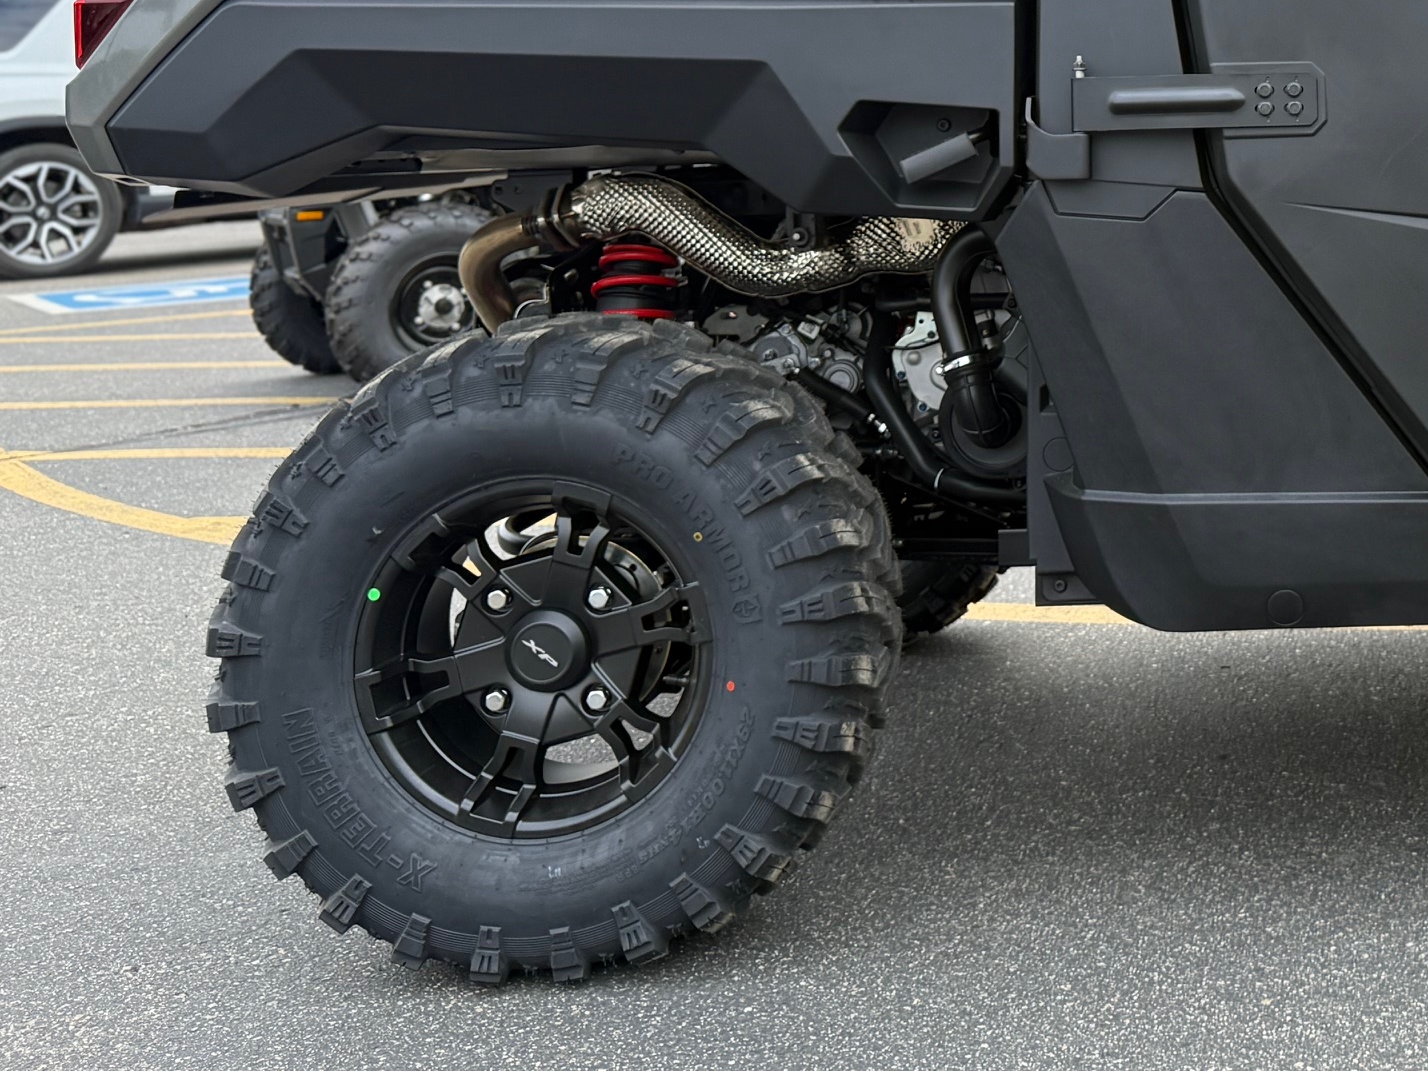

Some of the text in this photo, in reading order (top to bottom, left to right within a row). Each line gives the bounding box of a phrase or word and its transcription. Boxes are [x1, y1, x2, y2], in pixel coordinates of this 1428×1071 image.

[611, 442, 751, 594] PRO ARMOR
[520, 638, 559, 668] XP
[280, 707, 438, 893] X-TERRAIN
